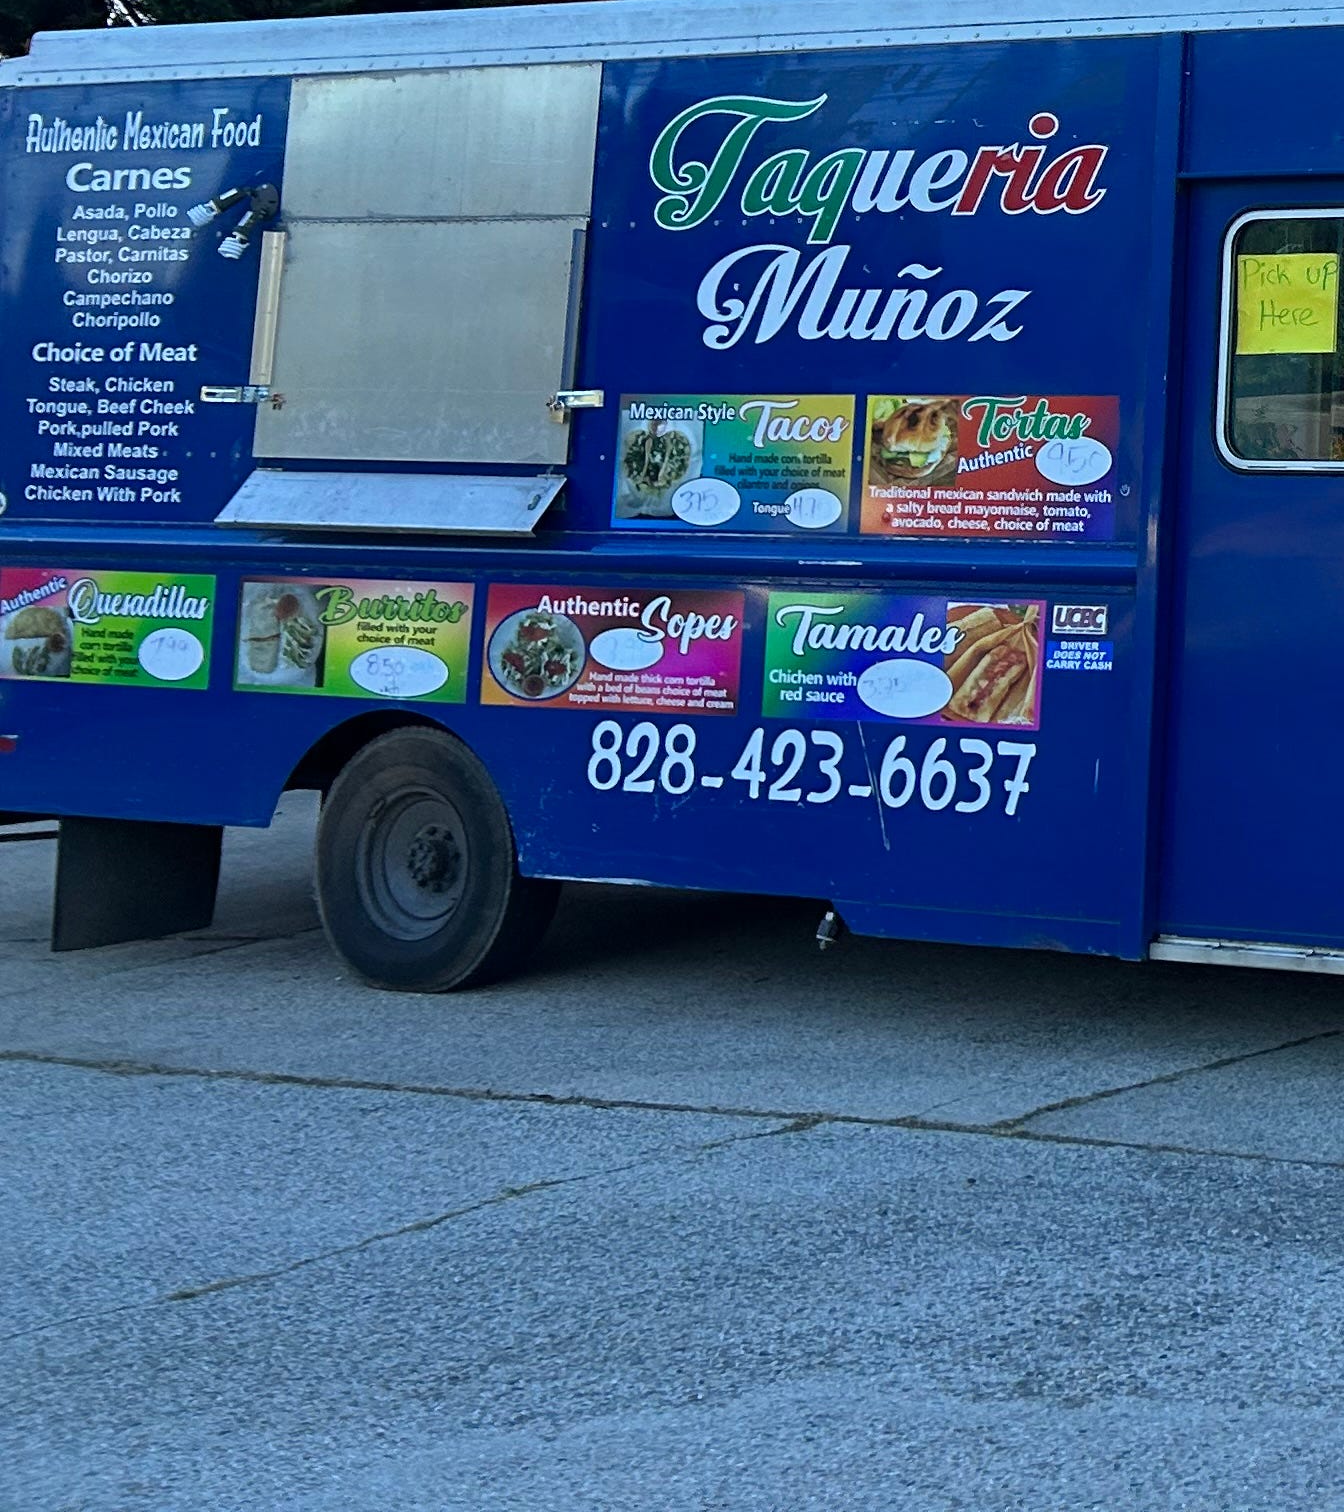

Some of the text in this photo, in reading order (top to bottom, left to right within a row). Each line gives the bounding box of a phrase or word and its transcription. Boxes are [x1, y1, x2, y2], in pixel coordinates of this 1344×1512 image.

[26, 107, 262, 153] Authentic Mexican Food
[65, 162, 192, 192] Carnes
[649, 93, 1108, 244] Taqueria
[72, 203, 178, 221] Asada, Pollo
[56, 225, 191, 245] Lengua, Cabeza
[55, 246, 189, 264] Pastor, Carnitas
[87, 268, 153, 284] Chorizo
[1240, 258, 1291, 290] Pick
[63, 290, 174, 308] Campechano
[697, 243, 1032, 350] Muñoz
[72, 311, 161, 330] Choripollo
[1260, 299, 1319, 331] Here
[32, 341, 198, 362] Choice of Meat
[48, 377, 174, 394] Steak, Chicken
[26, 398, 195, 417] Tongue, Beef Cheek
[138, 421, 179, 436] Pork
[629, 399, 849, 449] Mexican Style Tacos
[962, 395, 1092, 447] Tortas
[53, 442, 159, 458] Mixed Meats
[957, 443, 1033, 474] Authentic
[30, 464, 178, 484] Mexican Sausage
[24, 485, 182, 503] Chicken With Pork
[868, 485, 1112, 503] Traditional mexican sandwich made with
[753, 502, 791, 517] Tongue
[886, 502, 1091, 519] a salty bread mayonnaise, tomato,
[891, 515, 945, 529] avocado,
[993, 517, 1033, 531] choice
[1035, 518, 1051, 532] of
[1051, 521, 1085, 532] meat
[0, 576, 210, 624] Authentic Quesadillas
[315, 586, 469, 626] Burritos
[412, 626, 438, 636] your
[536, 595, 640, 618] Authentic
[637, 596, 738, 655] Sopes
[775, 604, 966, 656] Tamales
[357, 634, 435, 646] choice of meat
[1060, 641, 1099, 651] DRIVER
[1053, 650, 1106, 660] DOES NOT
[1046, 659, 1112, 670] CARRY CASH
[826, 671, 857, 687] with
[780, 687, 845, 703] red sauce
[587, 720, 1036, 816] 828-423-6637
